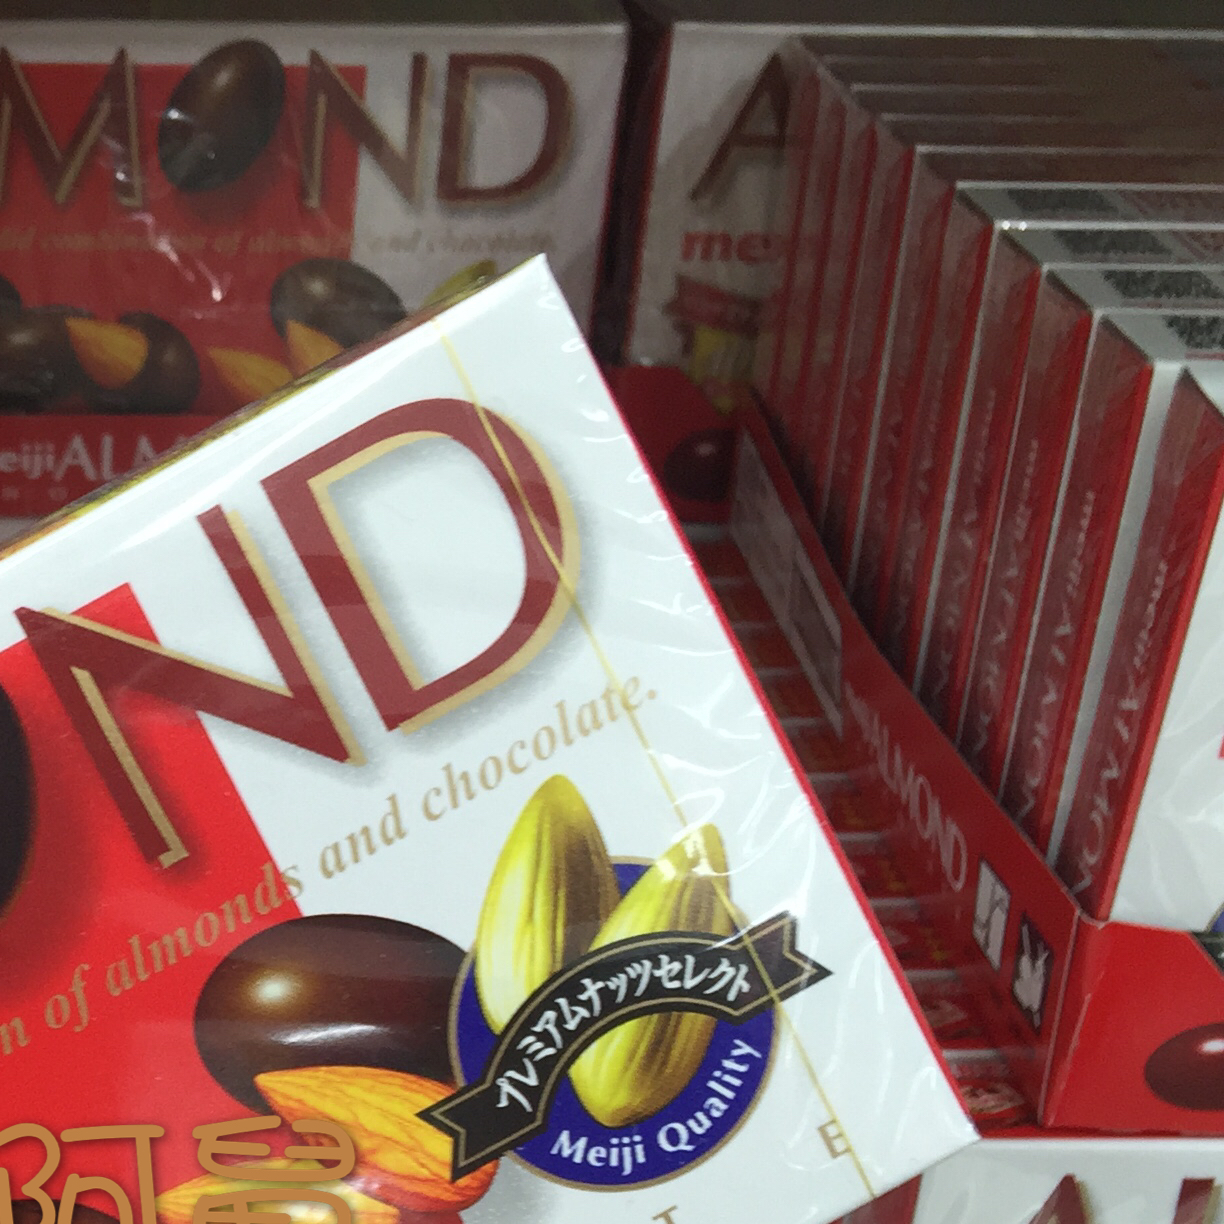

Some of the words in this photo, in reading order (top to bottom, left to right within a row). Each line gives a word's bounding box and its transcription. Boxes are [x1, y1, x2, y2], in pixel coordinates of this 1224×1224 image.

[43, 963, 93, 1034] of
[104, 863, 305, 998] almonds
[318, 792, 409, 881] and
[421, 675, 659, 822] chocolate.
[495, 954, 751, 1113] プレミアムナッツセレクト
[549, 1129, 647, 1176] Meiji
[656, 1038, 763, 1153] Quality
